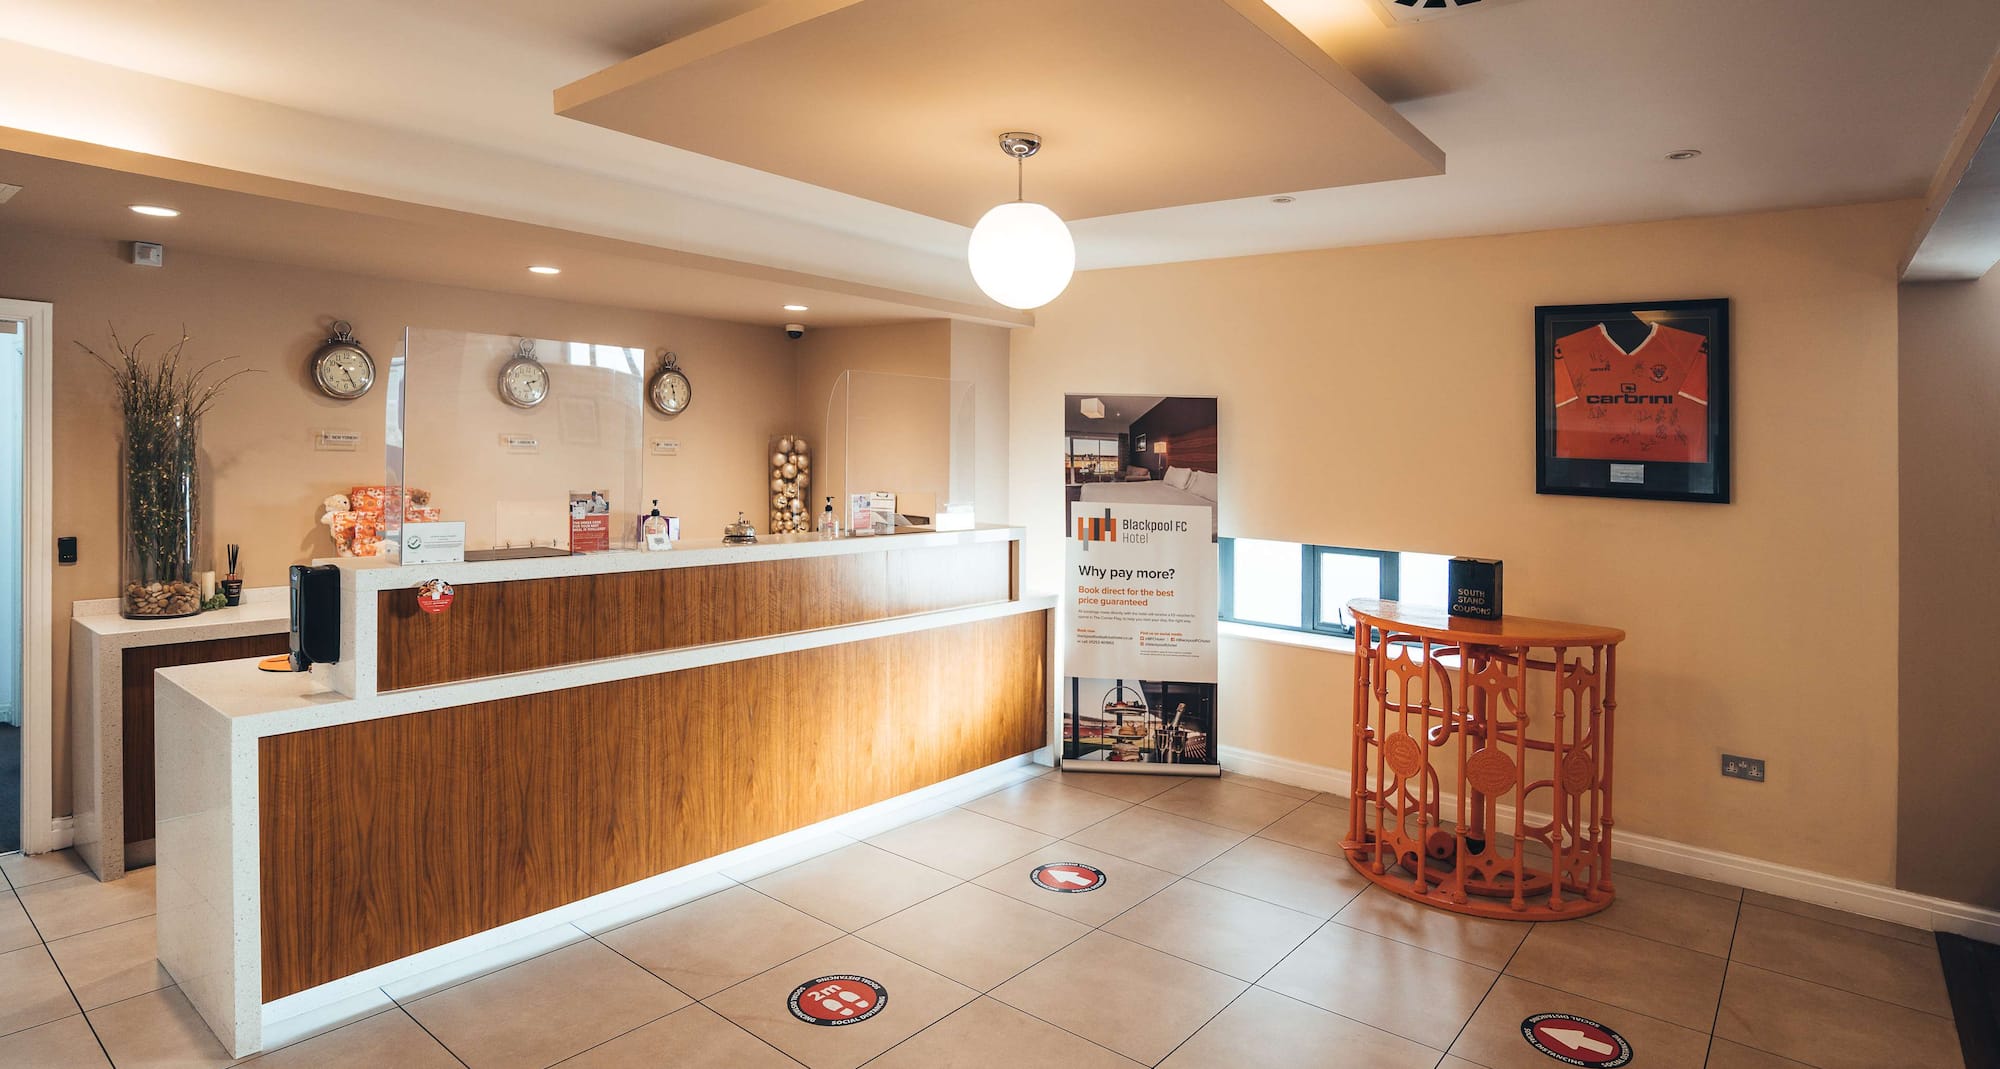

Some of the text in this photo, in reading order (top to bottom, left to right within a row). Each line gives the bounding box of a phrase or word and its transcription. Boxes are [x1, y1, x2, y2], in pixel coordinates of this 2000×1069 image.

[1586, 394, 1673, 404] carbrini
[1122, 519, 1188, 533] Blackpool FC
[1122, 533, 1148, 544] Hotel
[1079, 565, 1175, 580] Why pay more?
[1079, 586, 1100, 594] Book
[1102, 587, 1125, 595] direct
[1140, 588, 1154, 596] the
[1156, 589, 1174, 597] best
[1458, 588, 1485, 597] SOUTH
[1078, 597, 1148, 606] price guaranteed
[1458, 596, 1485, 605] STAND
[1453, 604, 1491, 615] COUPONS
[807, 984, 842, 1001] 2m
[832, 1017, 861, 1025] SOCIAL
[1571, 1016, 1600, 1028] SOCIAL
[1535, 1043, 1585, 1066] DISTANCING
